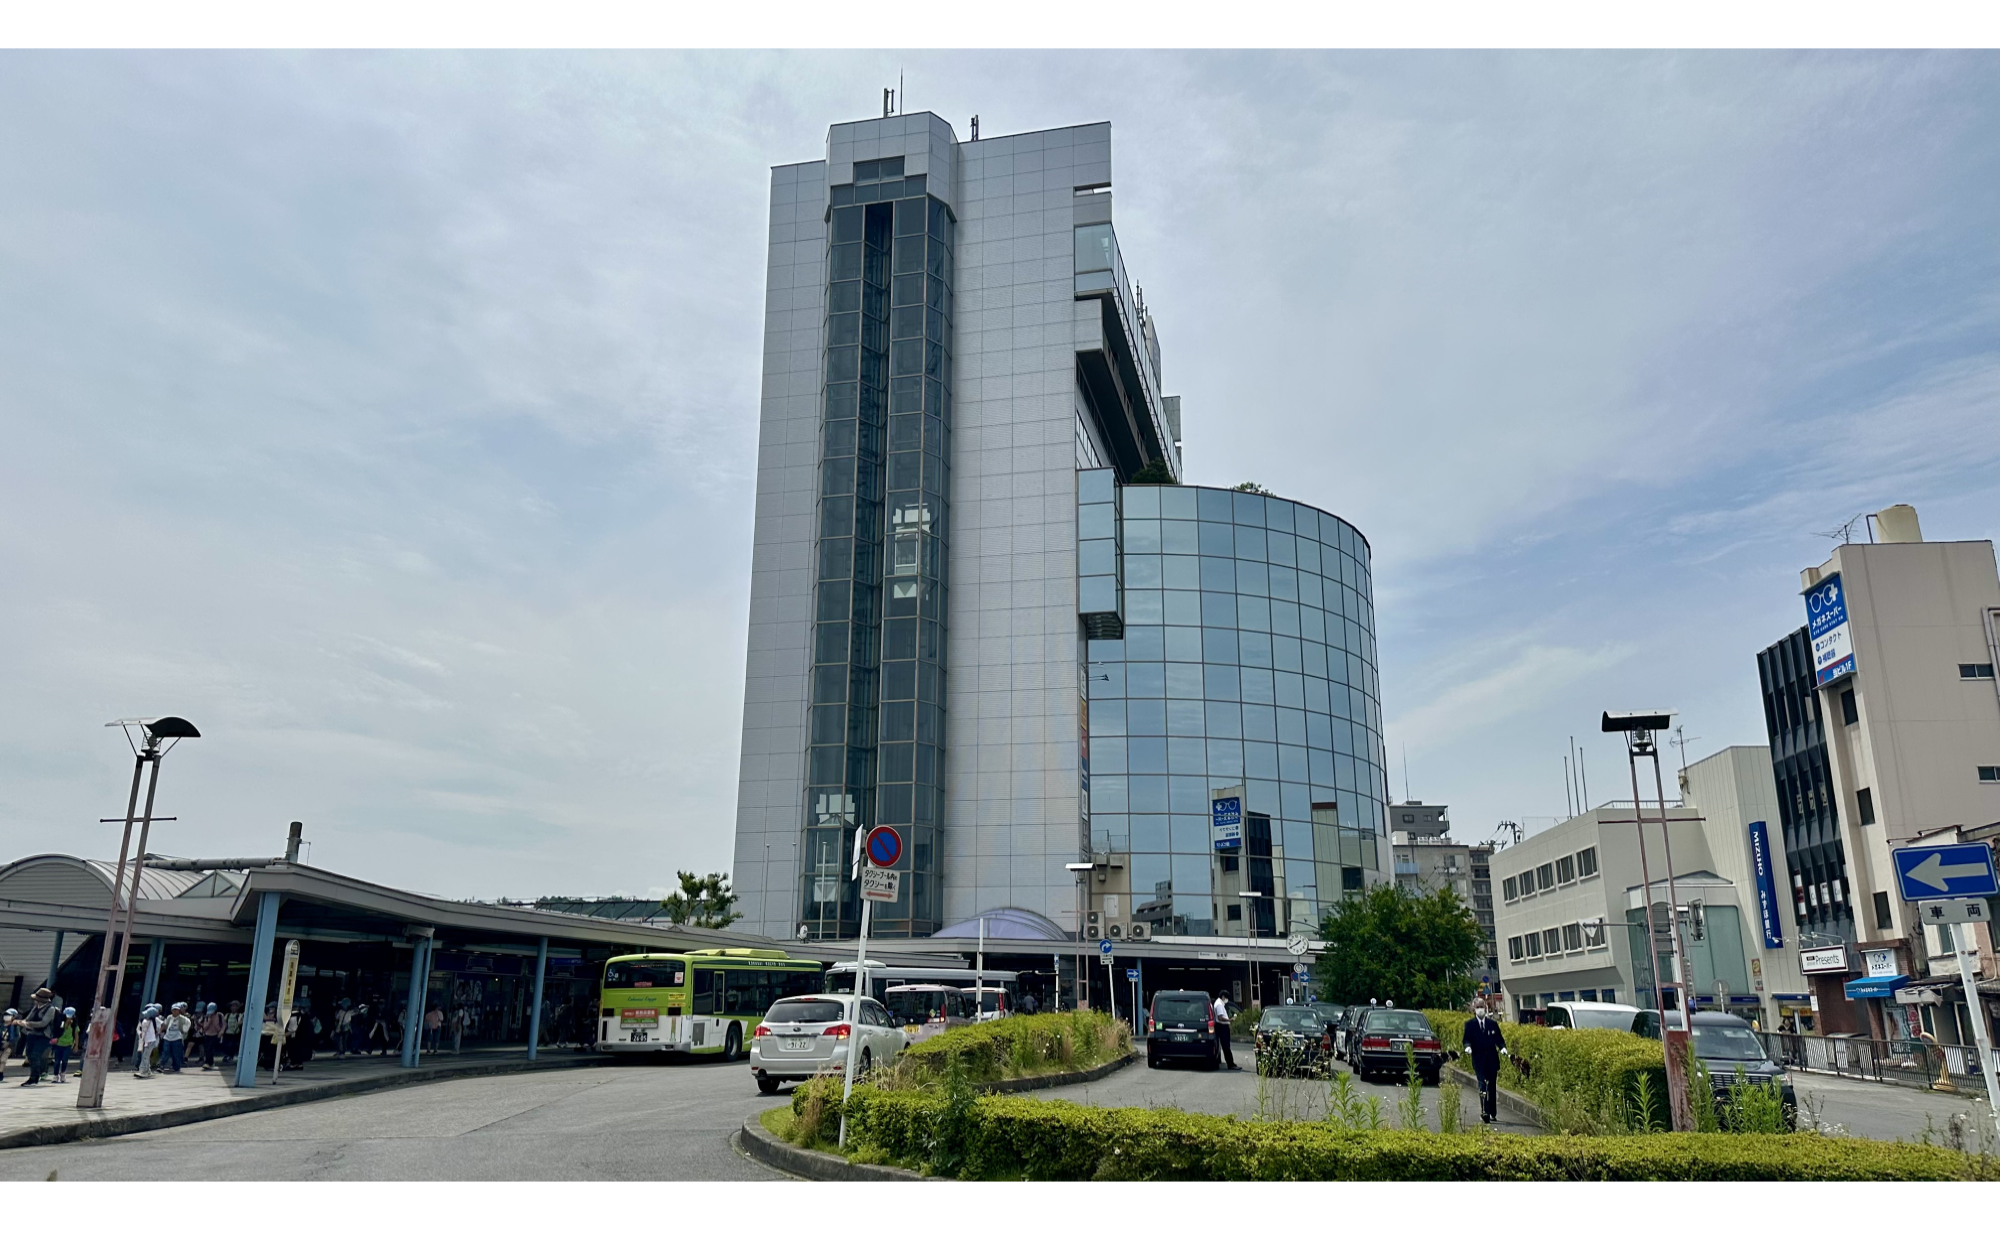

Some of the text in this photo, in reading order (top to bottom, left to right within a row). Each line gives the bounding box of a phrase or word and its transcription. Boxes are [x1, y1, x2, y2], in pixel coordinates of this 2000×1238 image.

[1812, 605, 1842, 629] メガネスーパー
[1820, 631, 1842, 650] コンタクト
[1753, 831, 1764, 876] MIZUHO
[1761, 890, 1772, 939] みずほ銀行
[1929, 903, 1982, 920] 車両
[1815, 954, 1840, 965] Presents
